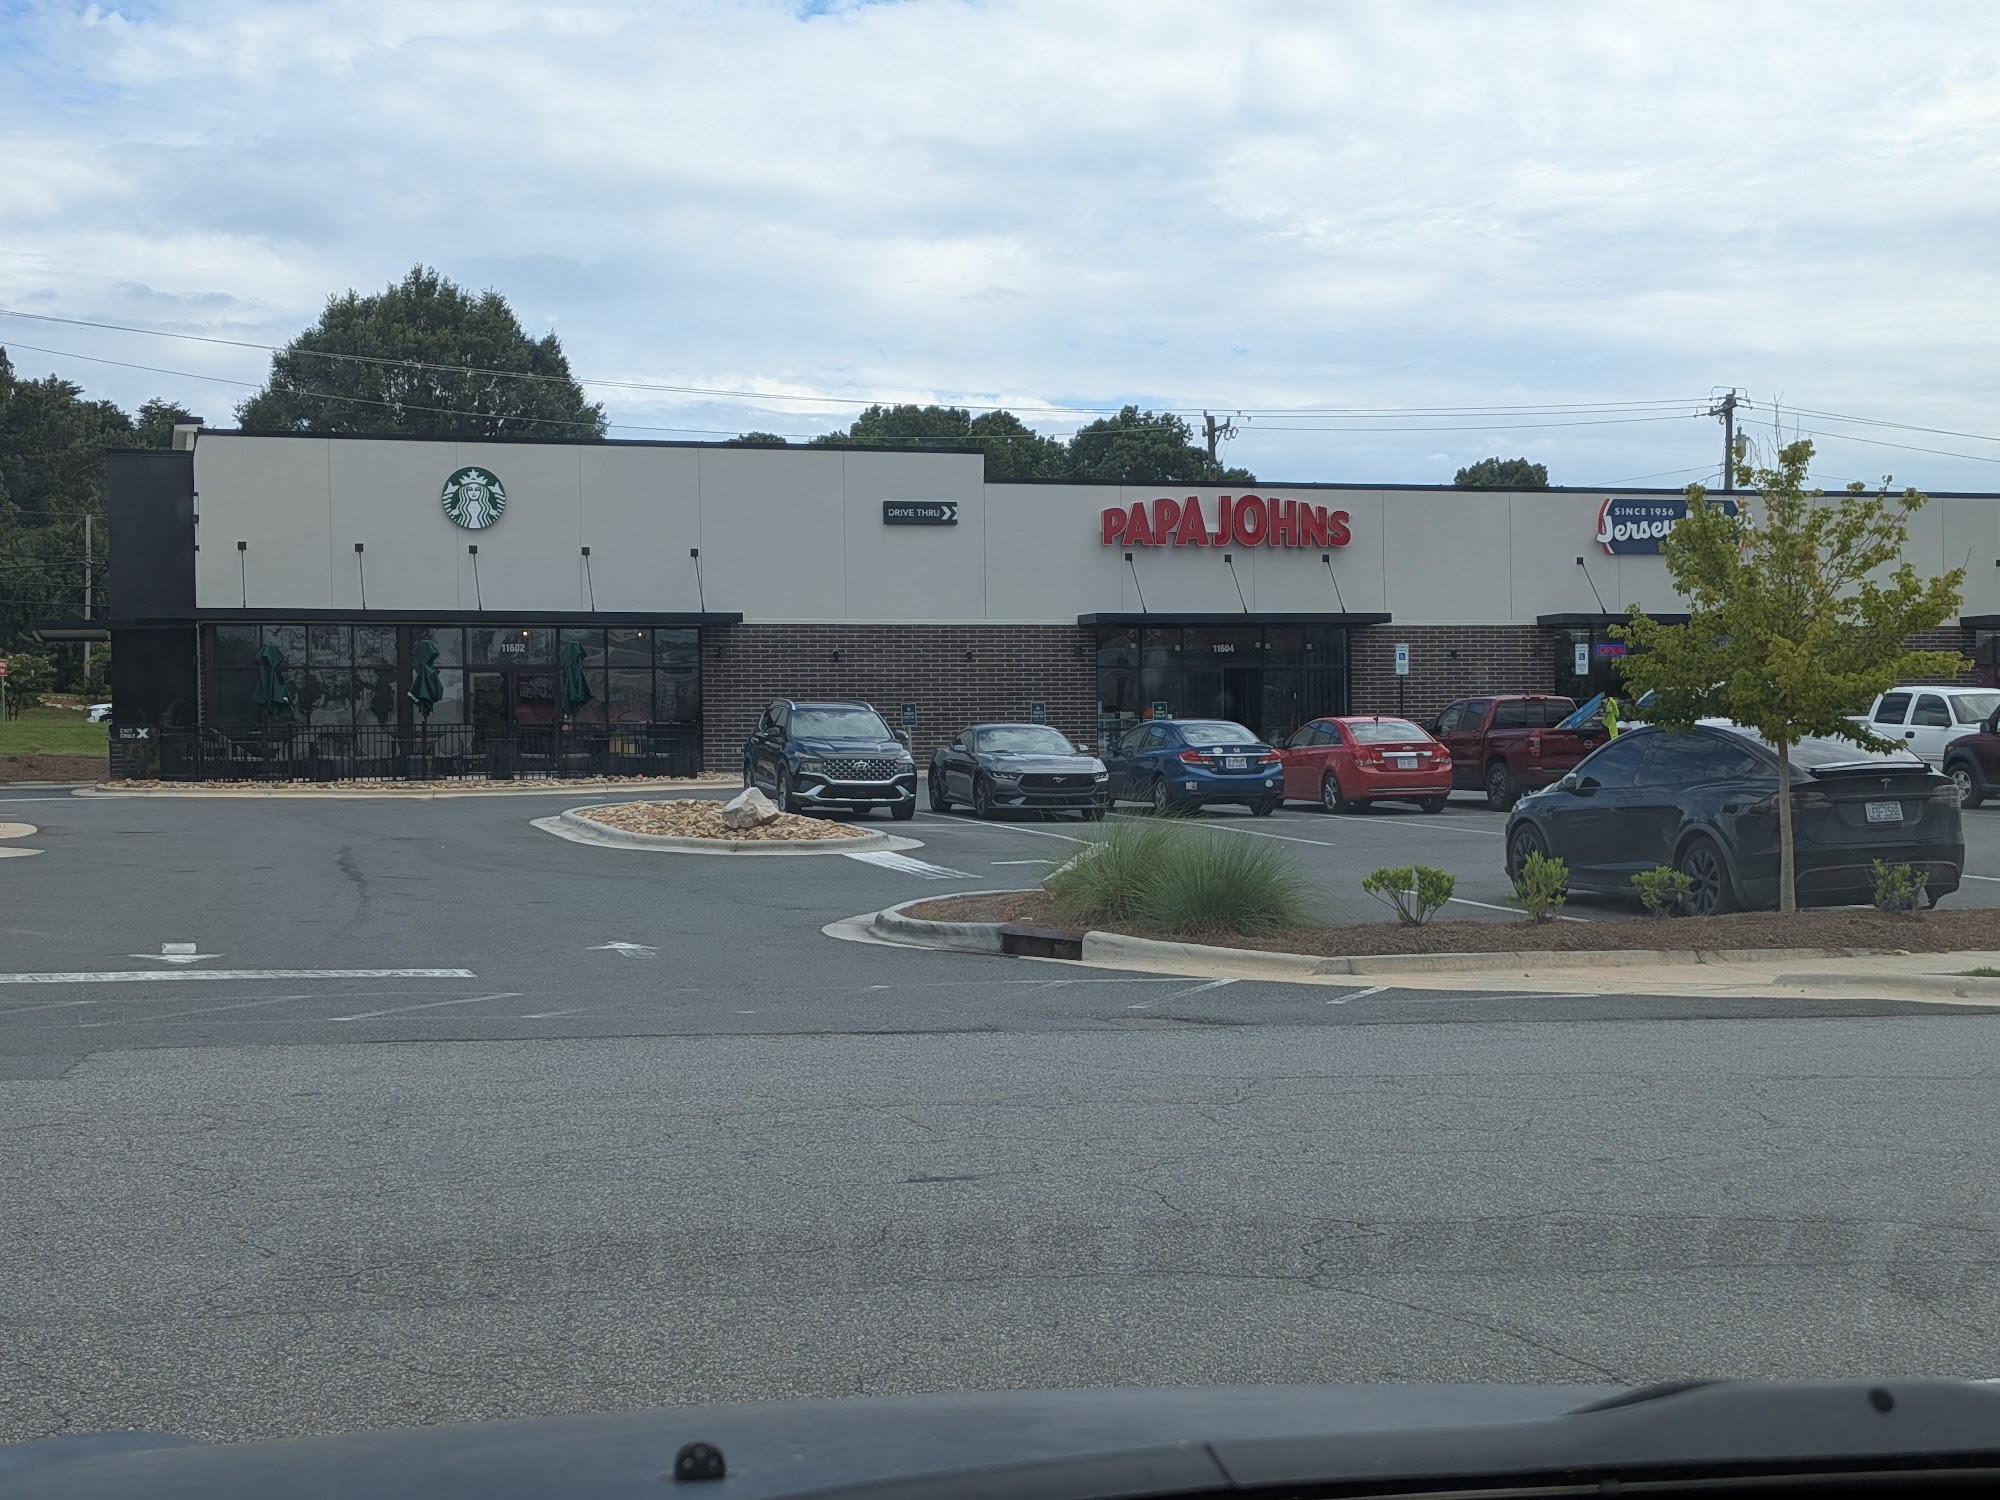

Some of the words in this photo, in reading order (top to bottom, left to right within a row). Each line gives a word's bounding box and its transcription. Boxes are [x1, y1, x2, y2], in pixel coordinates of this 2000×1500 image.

[888, 508, 915, 517] DRIVE
[916, 509, 940, 517] THRU
[1614, 507, 1647, 516] SINCE
[1650, 507, 1675, 517] 1956
[1101, 495, 1210, 547] PAPA
[1212, 494, 1352, 547] JOHNS
[501, 643, 525, 652] 11602
[1212, 644, 1235, 653] 11604
